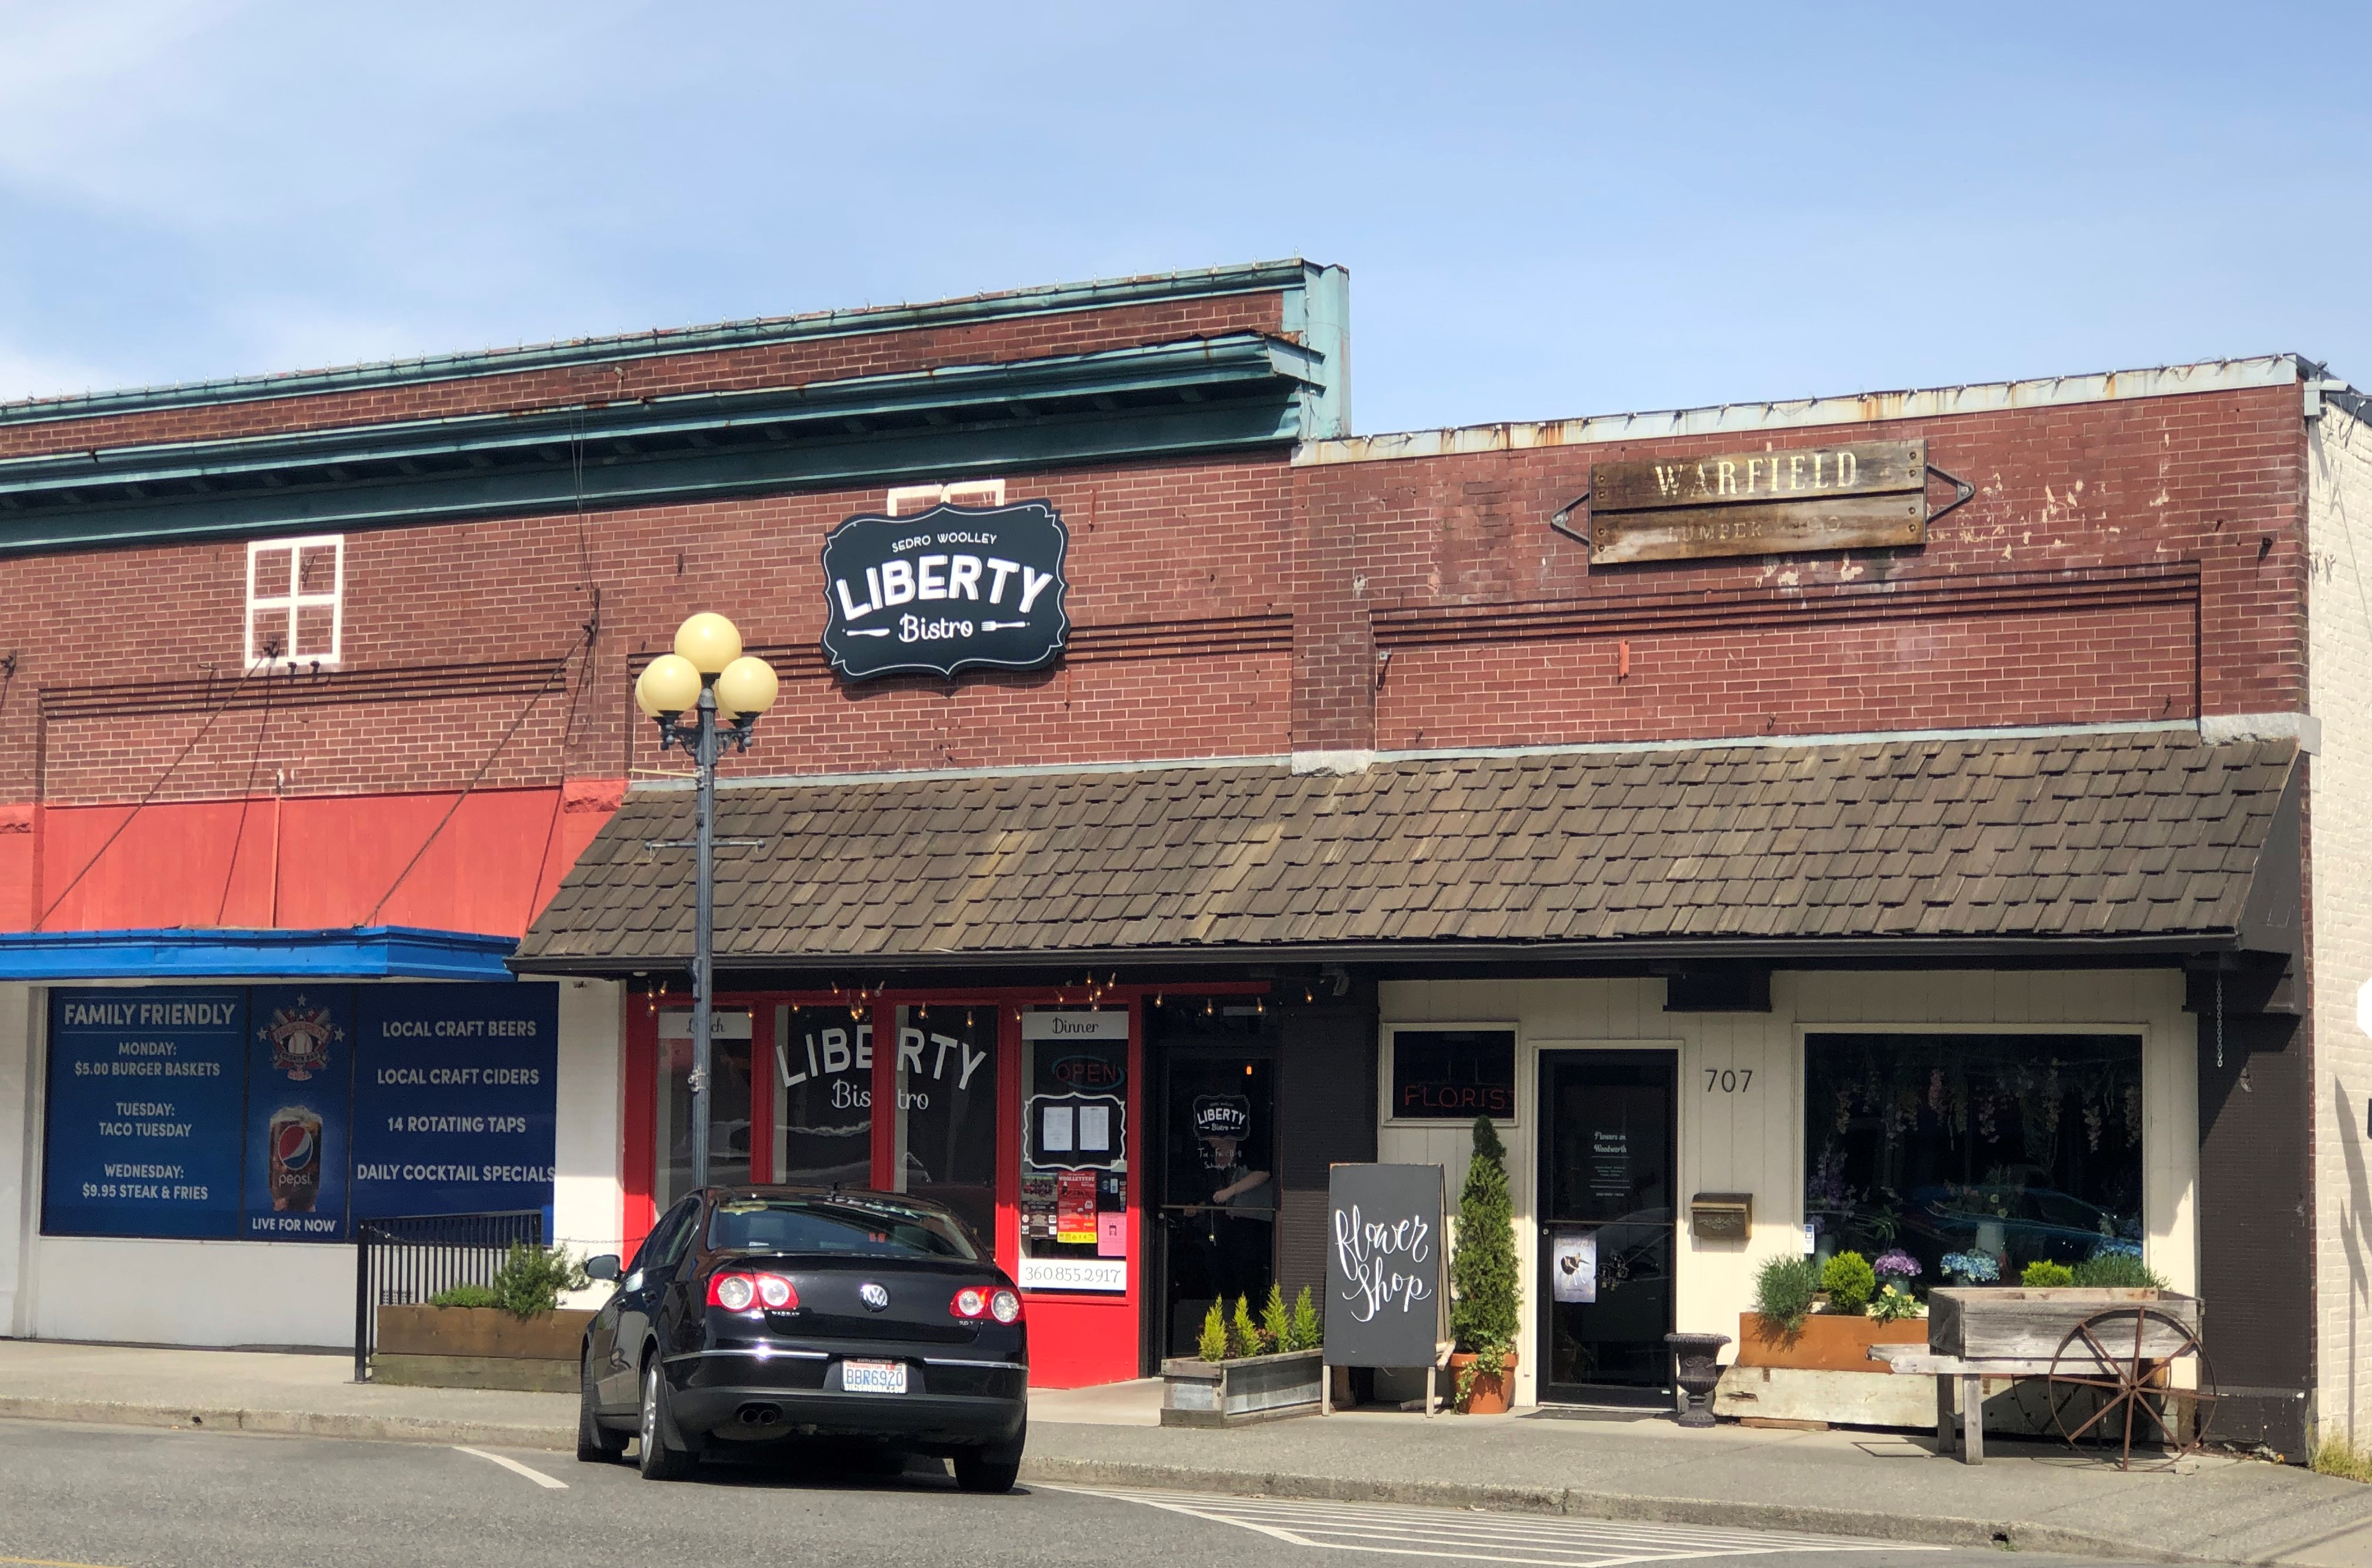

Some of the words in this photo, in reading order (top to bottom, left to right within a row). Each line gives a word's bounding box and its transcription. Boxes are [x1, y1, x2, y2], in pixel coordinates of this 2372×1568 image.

[1655, 452, 1857, 498] WARFIELD
[892, 535, 931, 552] SEDRO
[937, 532, 997, 544] WOOLLEY
[836, 555, 1052, 620] LIBERTY
[898, 613, 973, 642] Bistro
[64, 1003, 136, 1025] FAMILY
[140, 1003, 235, 1025] FRIENDLY
[382, 1021, 431, 1037] LOCAL
[435, 1021, 484, 1036] CRAFT
[488, 1021, 537, 1036] BEERS
[686, 1017, 725, 1034] Lch
[1052, 1016, 1099, 1034] Dinner
[118, 1042, 176, 1055] MONDAY:
[776, 1025, 987, 1090] LIBERTY
[75, 1061, 108, 1076] $5.00
[112, 1062, 162, 1076] BURGER
[165, 1063, 221, 1076] BASKETS
[377, 1069, 426, 1084] LOCAL
[429, 1069, 479, 1084] CRAFT
[482, 1069, 539, 1084] CIDERS
[1056, 1063, 1117, 1083] OPEN
[1704, 1069, 1753, 1092] 707
[831, 1079, 929, 1110] Bistro
[116, 1102, 175, 1116] TUESDAY:
[1197, 1107, 1246, 1125] LIBERTY
[99, 1122, 132, 1136] TACO
[135, 1123, 192, 1137] TUESDAY
[388, 1117, 404, 1132] 14
[408, 1117, 485, 1132] ROTATING
[488, 1117, 526, 1133] TAPS
[104, 1163, 184, 1179] WEDNESDAY:
[278, 1173, 311, 1187] pepsi
[357, 1164, 401, 1180] DAILY
[403, 1165, 479, 1181] COCKTAIL
[482, 1166, 555, 1182] SPECIALS
[82, 1182, 116, 1199] $9.95
[119, 1185, 158, 1199] STEAK
[161, 1186, 171, 1199] &
[174, 1186, 208, 1200] FRIES
[252, 1217, 275, 1230] LIVE
[279, 1218, 301, 1231] FOR
[305, 1219, 336, 1232] NOW
[1025, 1266, 1121, 1283] 360.855.2917
[847, 1369, 904, 1387] BBR6920
